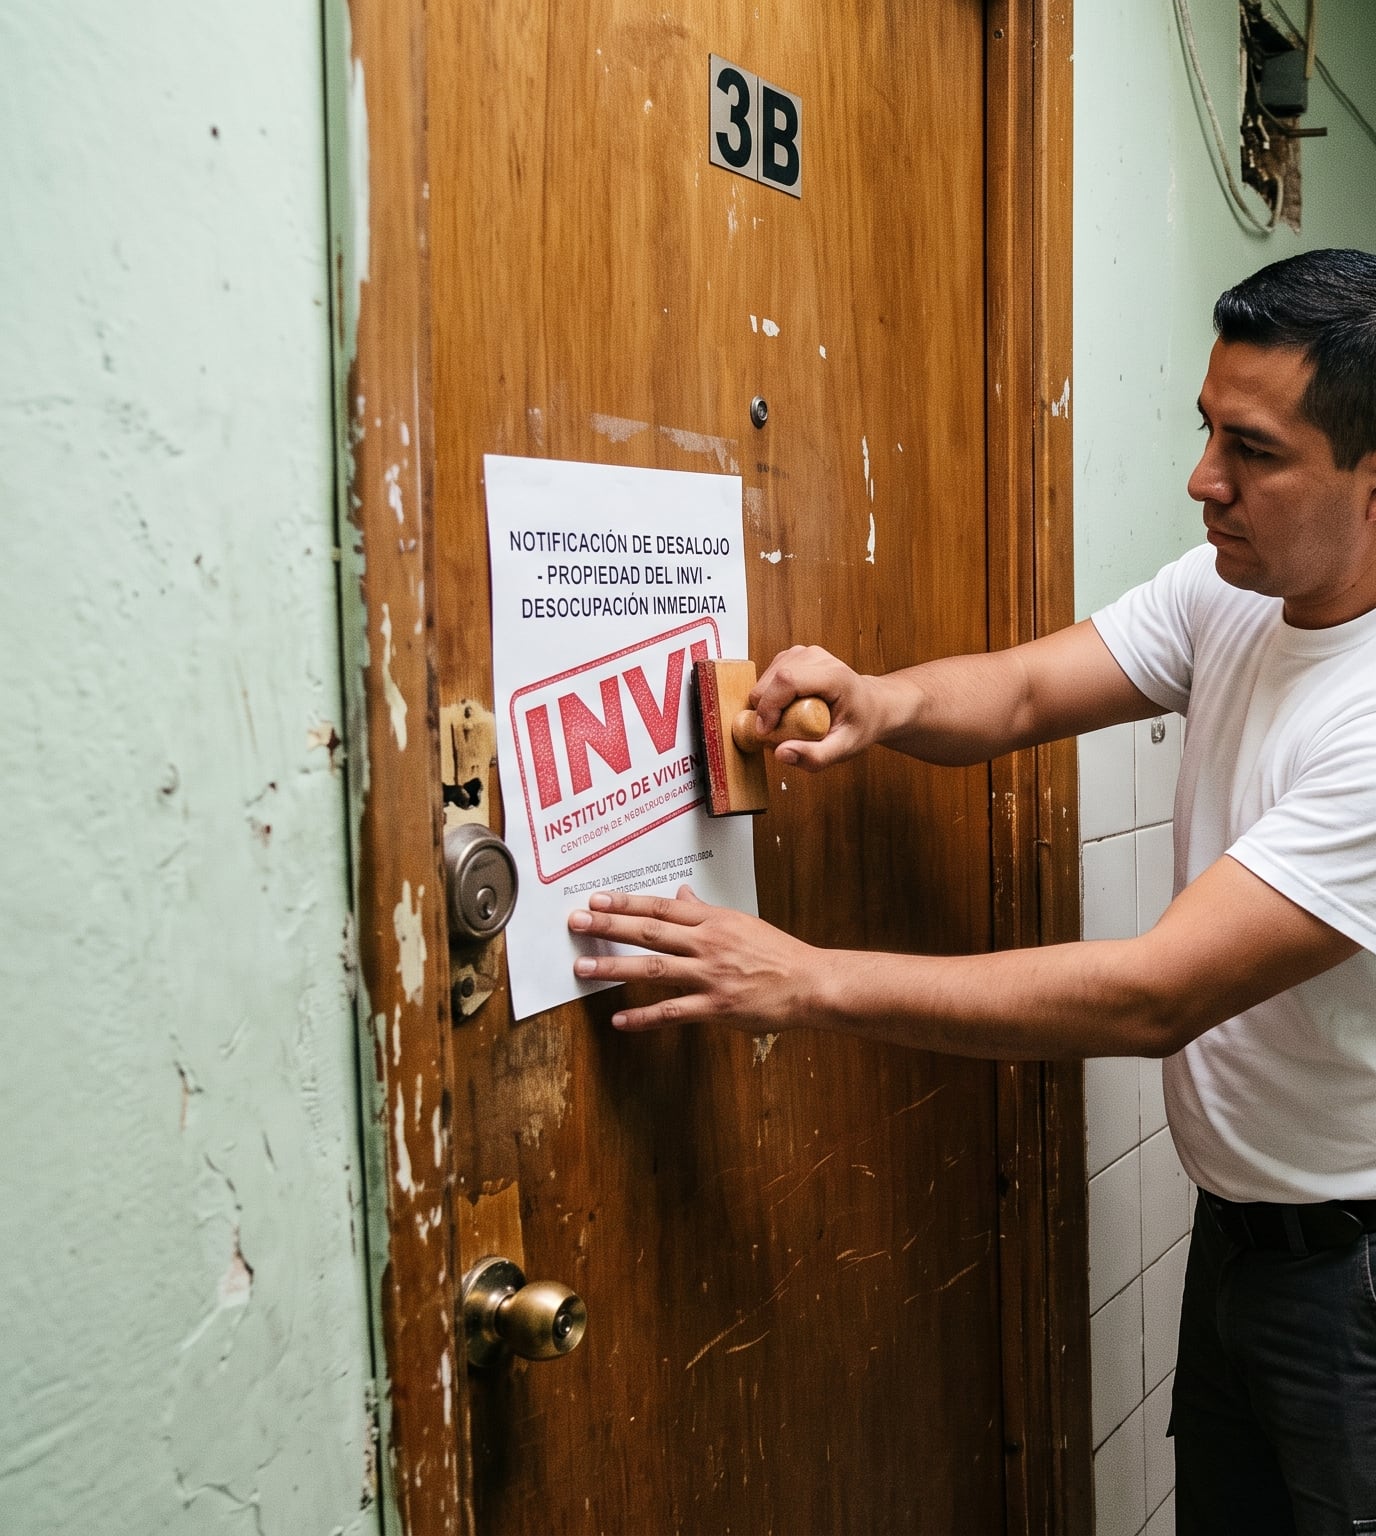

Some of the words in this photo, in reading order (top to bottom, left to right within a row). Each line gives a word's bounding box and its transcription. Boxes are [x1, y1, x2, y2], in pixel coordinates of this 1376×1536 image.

[716, 67, 800, 187] 3B
[509, 529, 628, 554] NOTIFICACIÓN
[632, 535, 652, 554] DE
[656, 535, 731, 556] DESALOJO
[547, 565, 640, 585] PROPIEDAD
[645, 566, 673, 585] DEL
[677, 566, 703, 585] INVI
[522, 592, 649, 619] DESOCUPACIÓN
[653, 595, 727, 616] INMEDIATA
[525, 639, 710, 810] INV
[544, 788, 627, 843] INSTITUTO
[631, 775, 652, 800] DE
